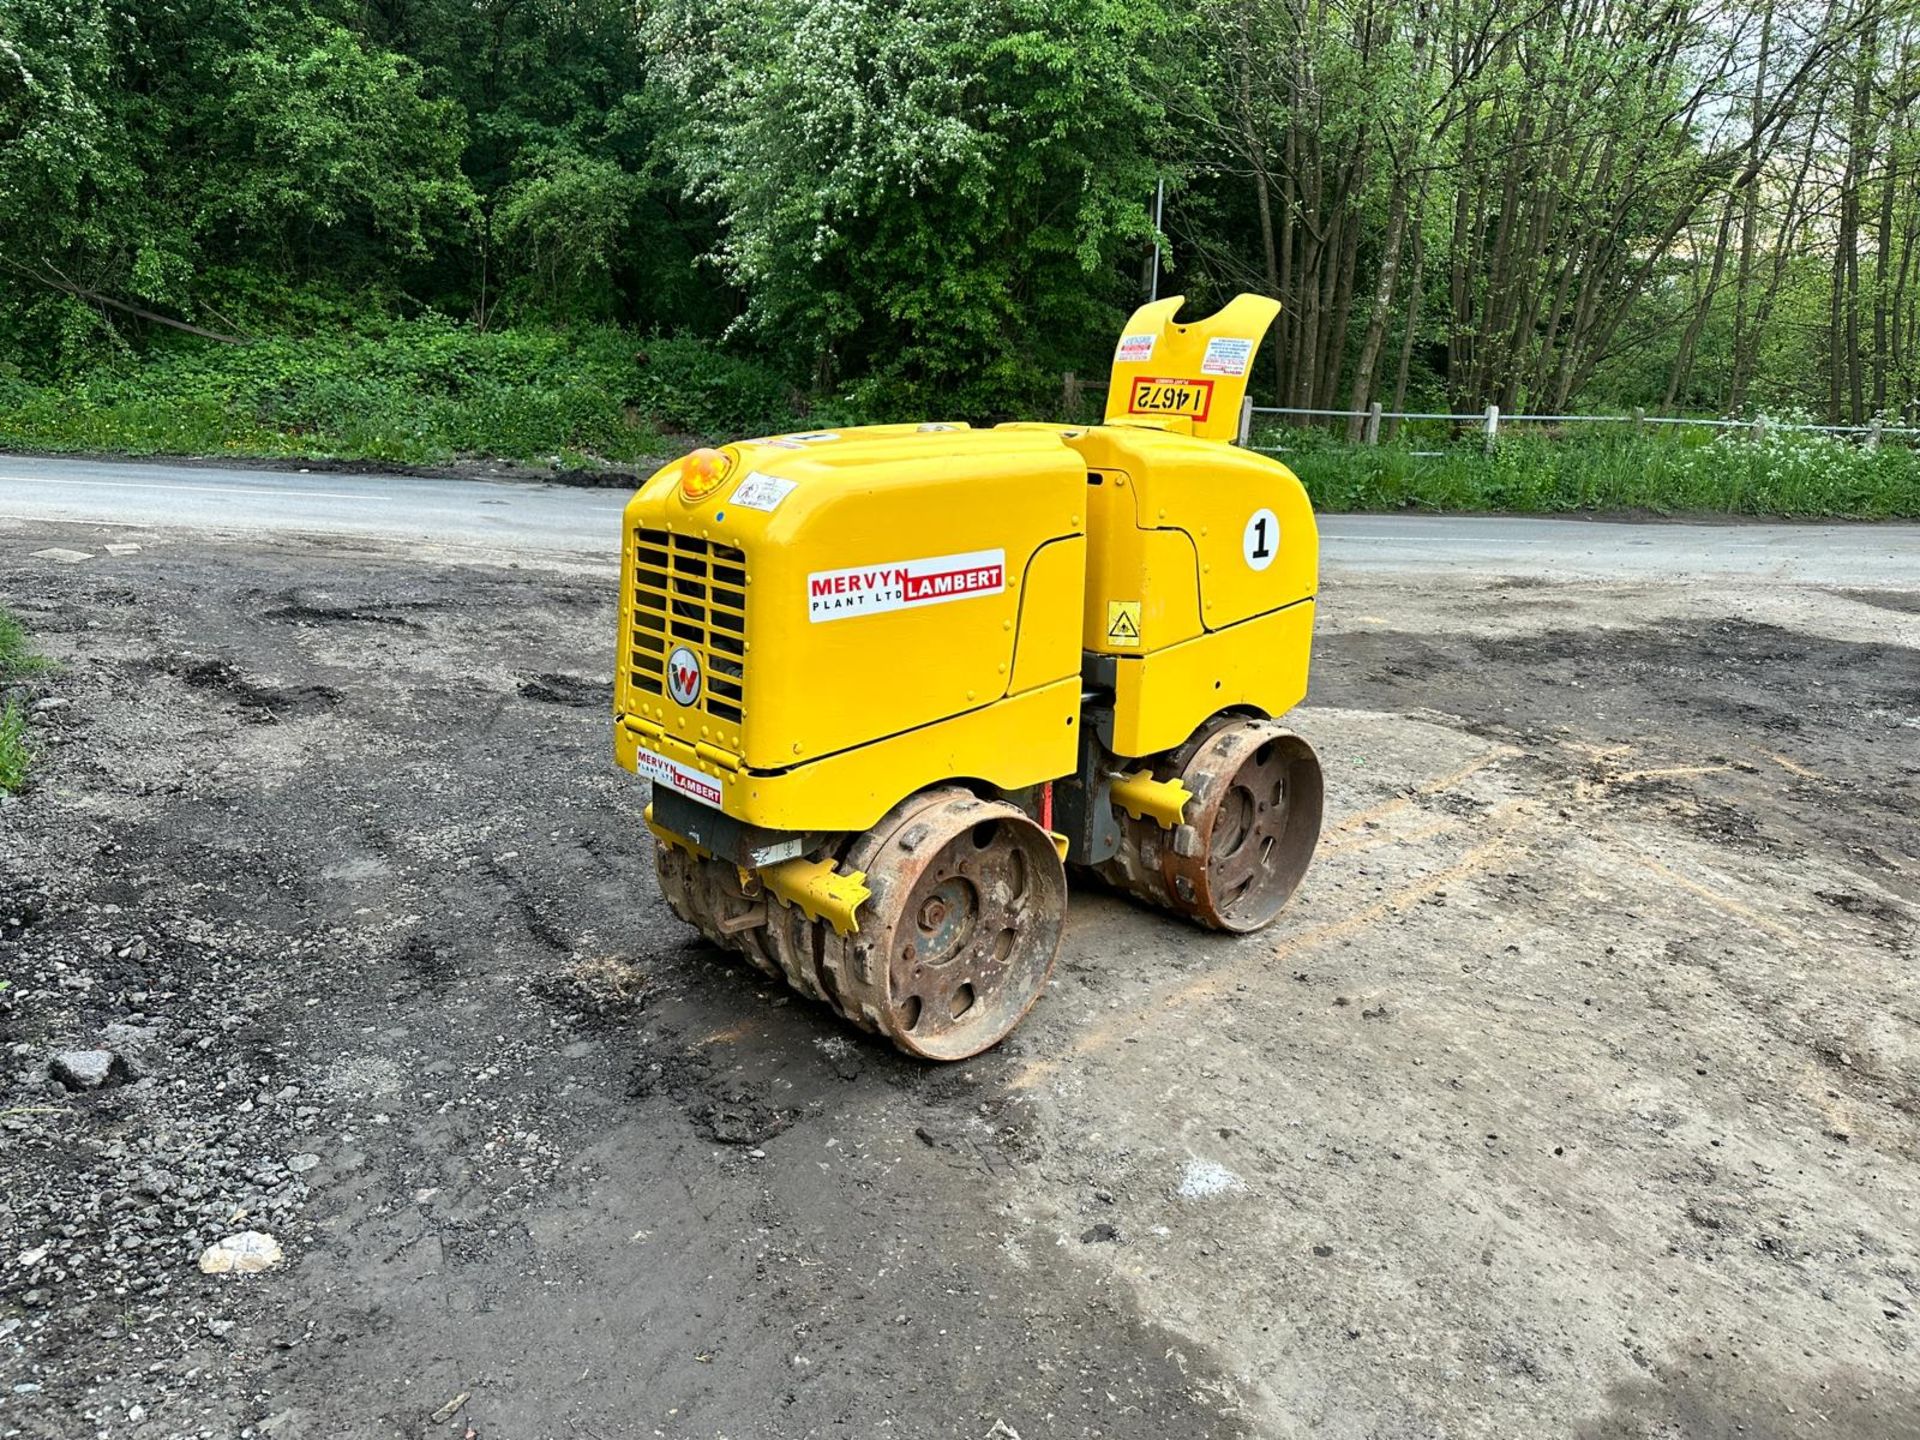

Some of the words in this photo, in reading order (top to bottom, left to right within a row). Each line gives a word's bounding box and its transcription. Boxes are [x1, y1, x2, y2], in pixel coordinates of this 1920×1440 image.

[1138, 386, 1201, 411] 14672
[1252, 518, 1269, 558] 1
[811, 568, 908, 597] MERVYN
[907, 568, 1000, 598] LAMBERT
[813, 596, 864, 611] PLANT
[876, 590, 902, 602] LTD
[638, 751, 677, 774] MERVYN
[674, 774, 720, 802] LAMBERT
